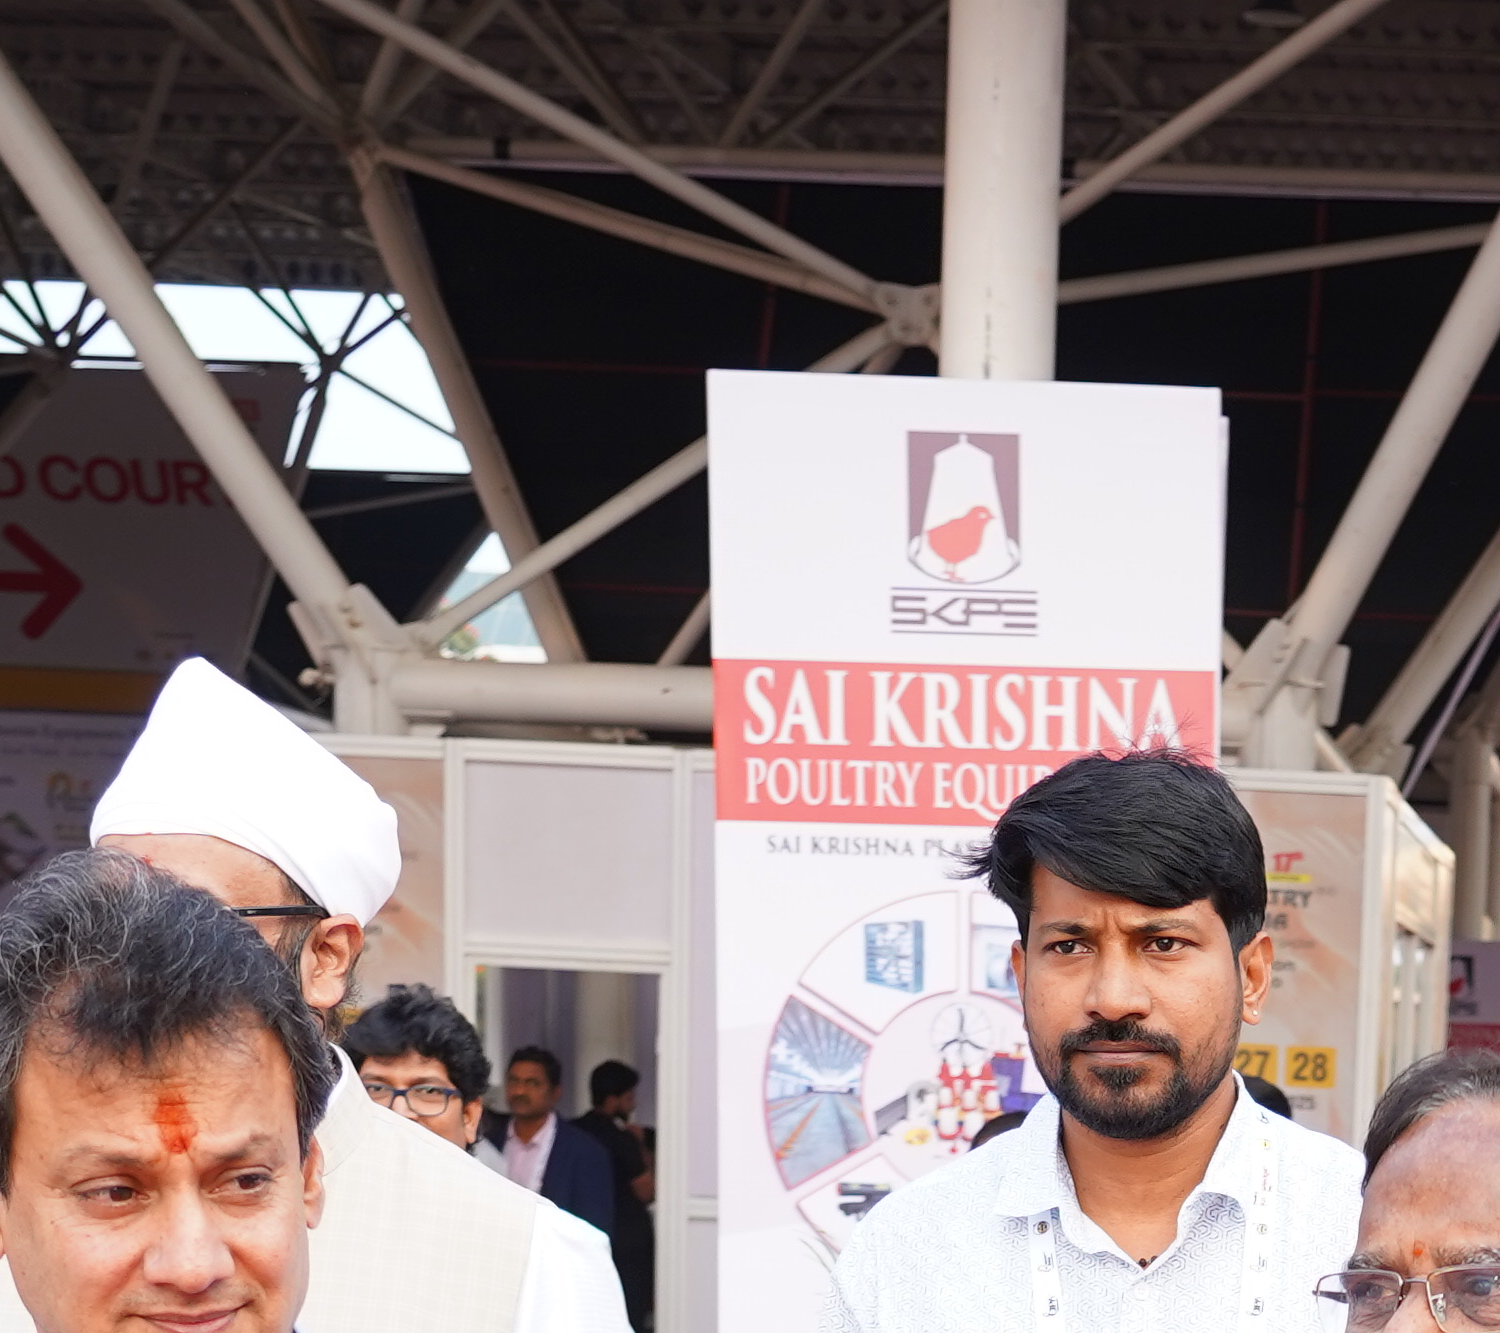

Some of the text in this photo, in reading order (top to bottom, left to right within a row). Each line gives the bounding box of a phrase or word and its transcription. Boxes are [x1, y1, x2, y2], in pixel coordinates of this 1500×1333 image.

[38, 454, 234, 507] COUR
[743, 666, 1183, 753] SAI KRISHNA
[744, 757, 924, 808] POULTRY
[767, 835, 800, 854] SAI
[811, 836, 915, 857] KRISHNA
[1293, 1051, 1328, 1082] 28
